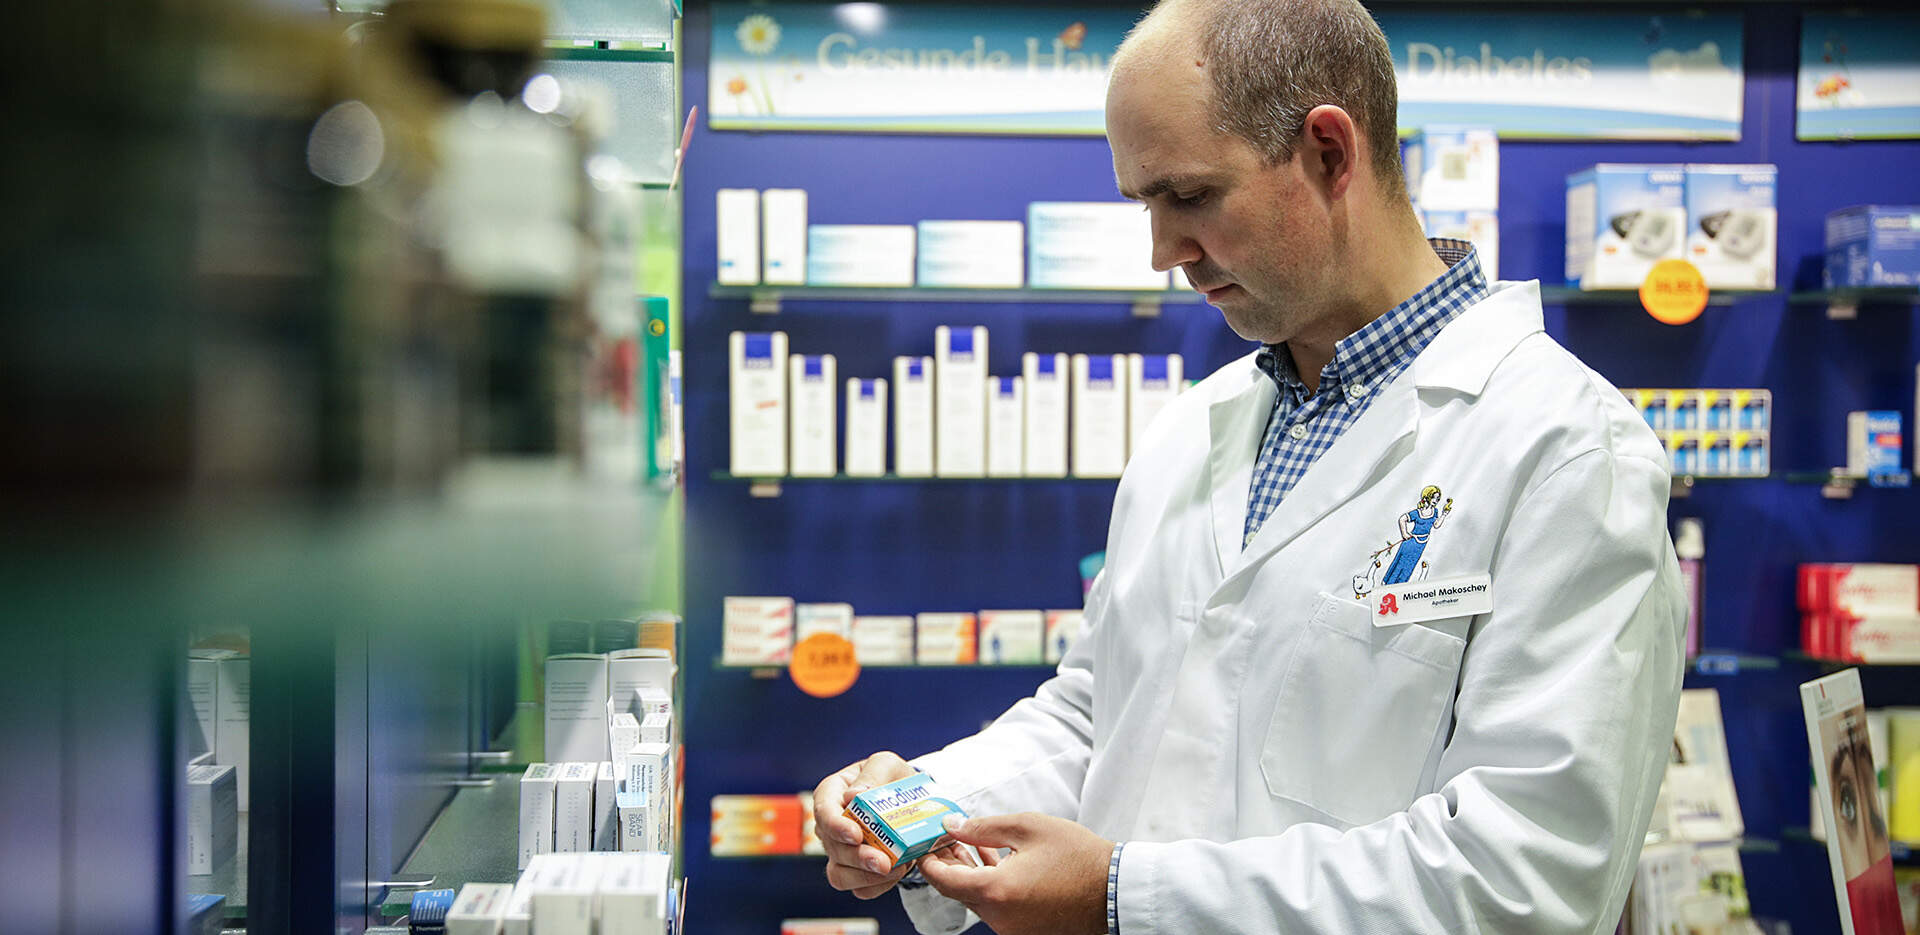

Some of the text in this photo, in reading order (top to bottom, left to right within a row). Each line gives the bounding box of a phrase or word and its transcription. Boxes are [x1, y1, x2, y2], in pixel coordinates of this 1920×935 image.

[817, 32, 1110, 76] Gesunde Hau
[1407, 41, 1592, 83] Diabetes
[1403, 583, 1488, 601] Michael Makoschey
[1431, 597, 1459, 606] Apotheker
[868, 785, 930, 812] Imodium
[851, 802, 895, 849] Imodium
